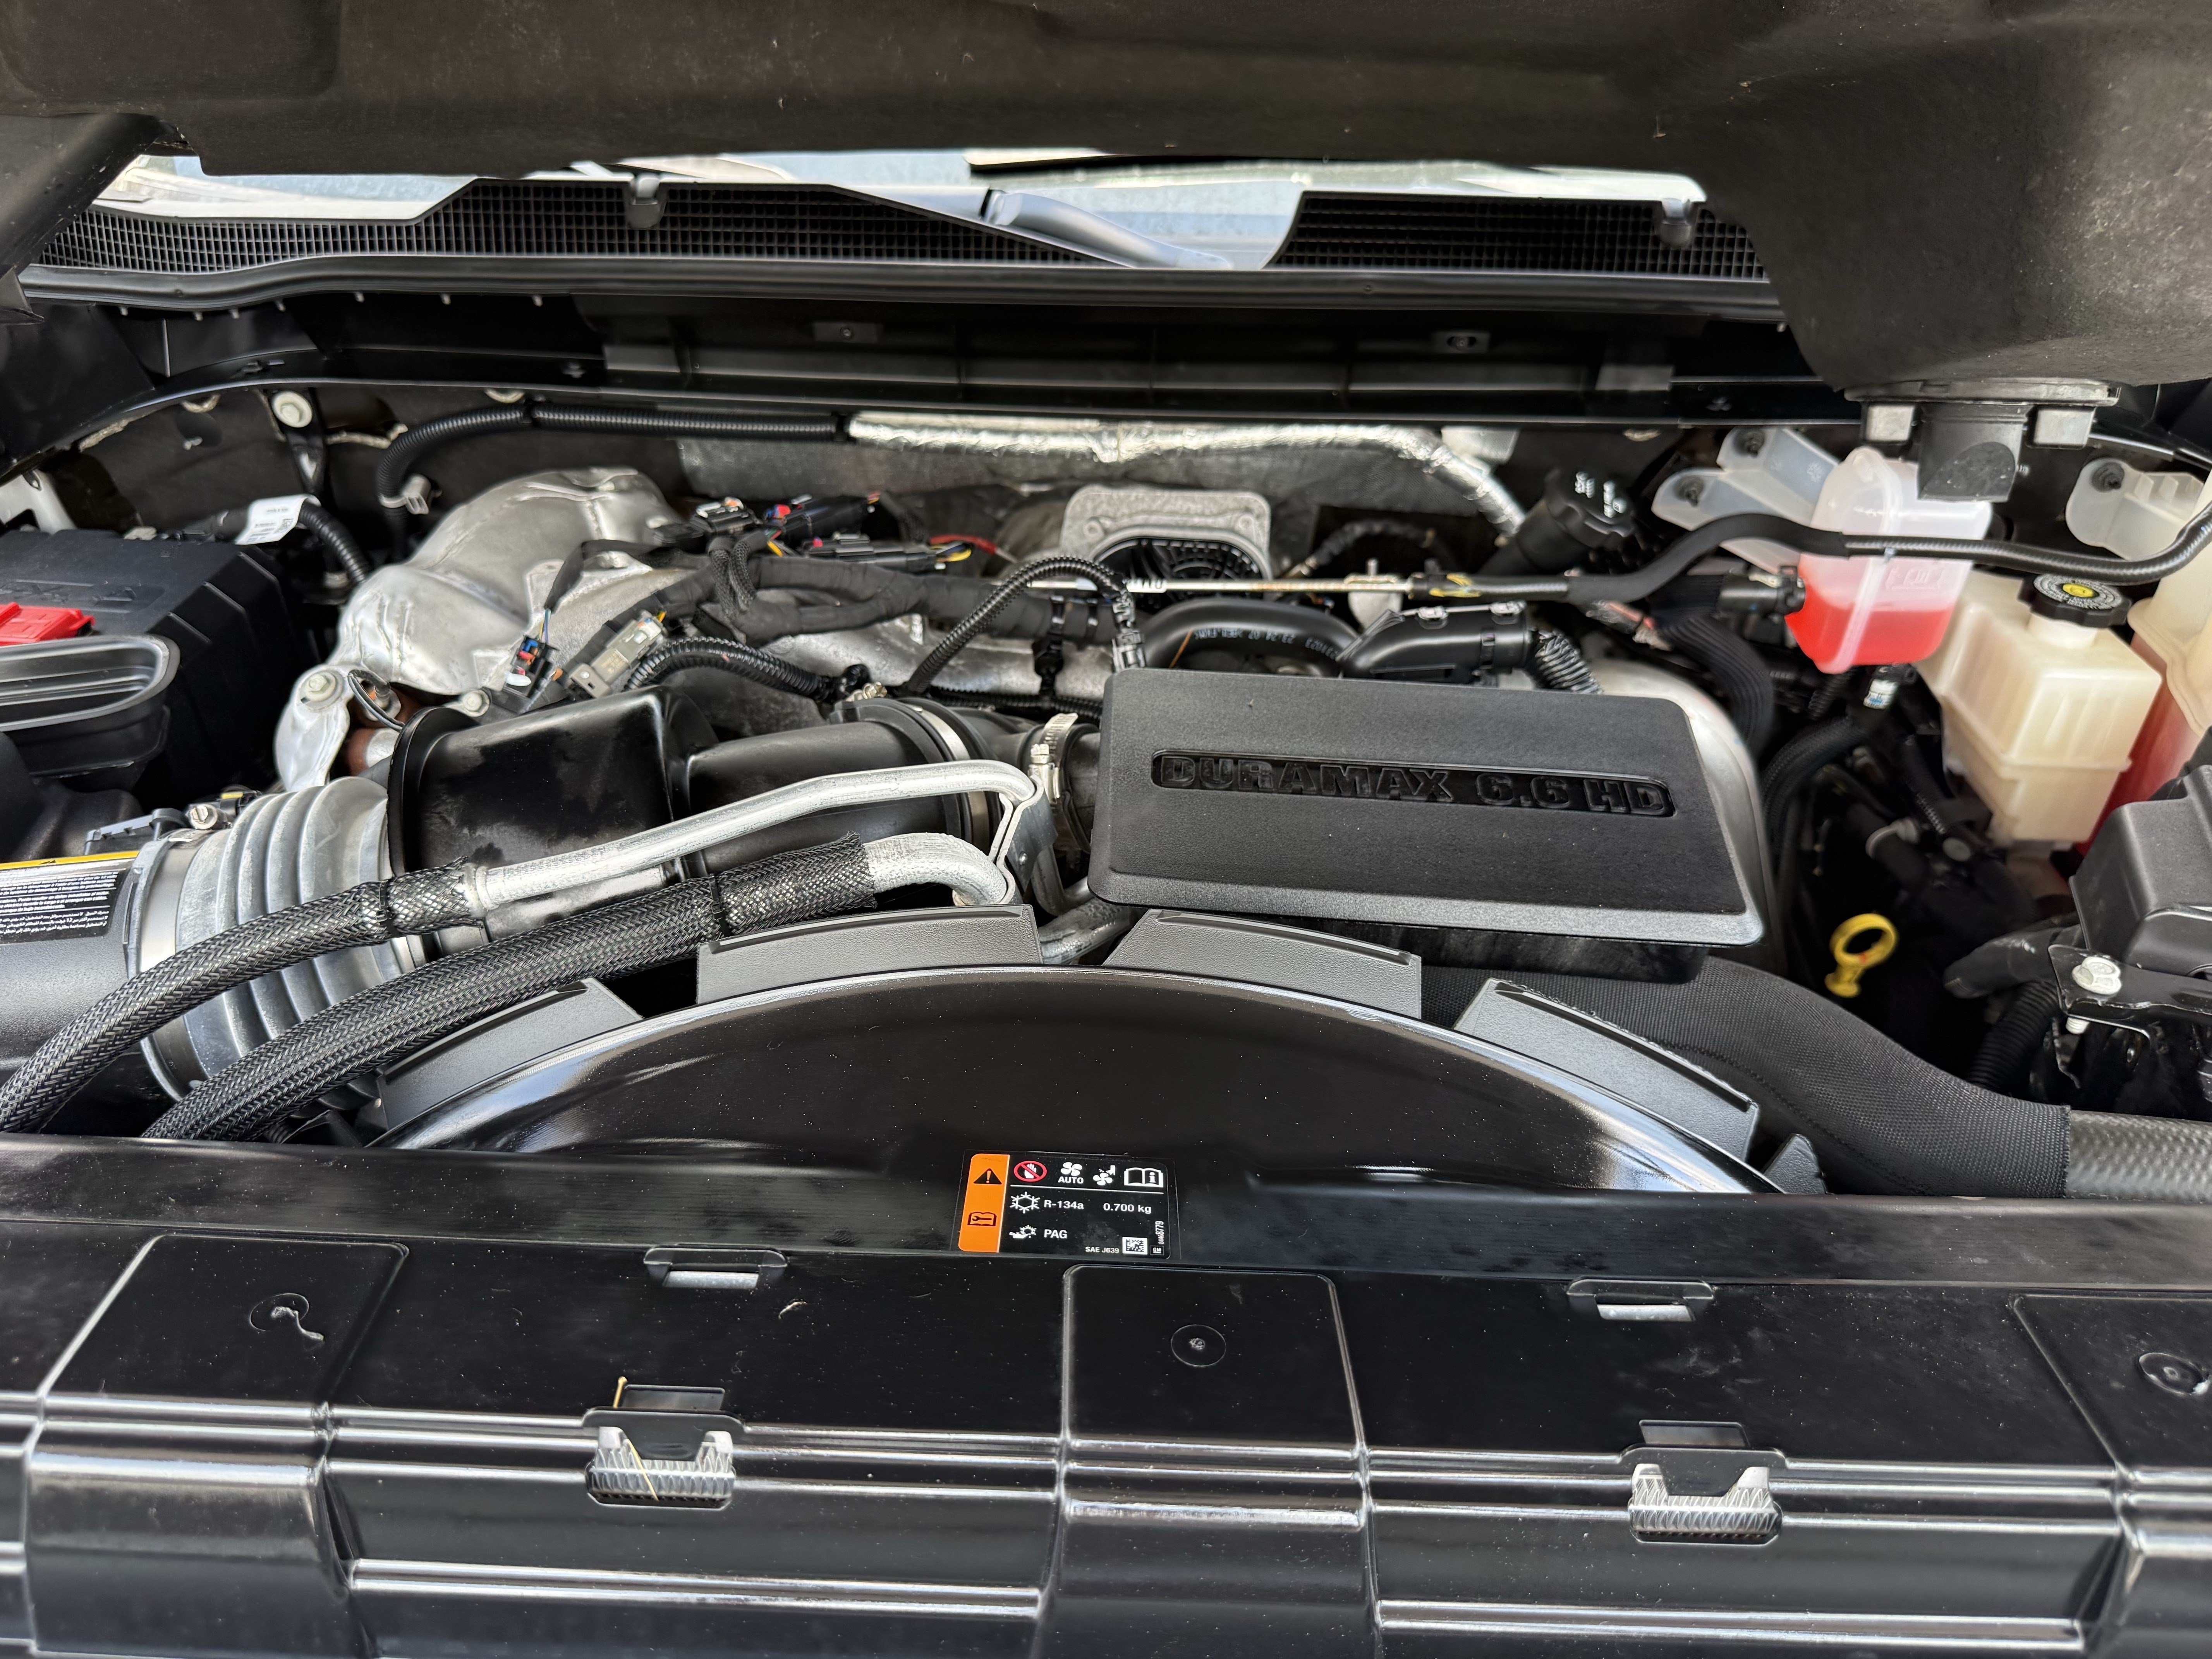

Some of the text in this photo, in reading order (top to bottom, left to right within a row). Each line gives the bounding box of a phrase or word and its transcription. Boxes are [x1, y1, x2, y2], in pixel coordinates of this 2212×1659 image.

[1161, 756, 1664, 815] DURAMAX 6.6 HD
[1058, 1176, 1084, 1184] AUTO
[1044, 1200, 1152, 1214] R-134a 0.700 kg
[1044, 1229, 1068, 1239] PAG
